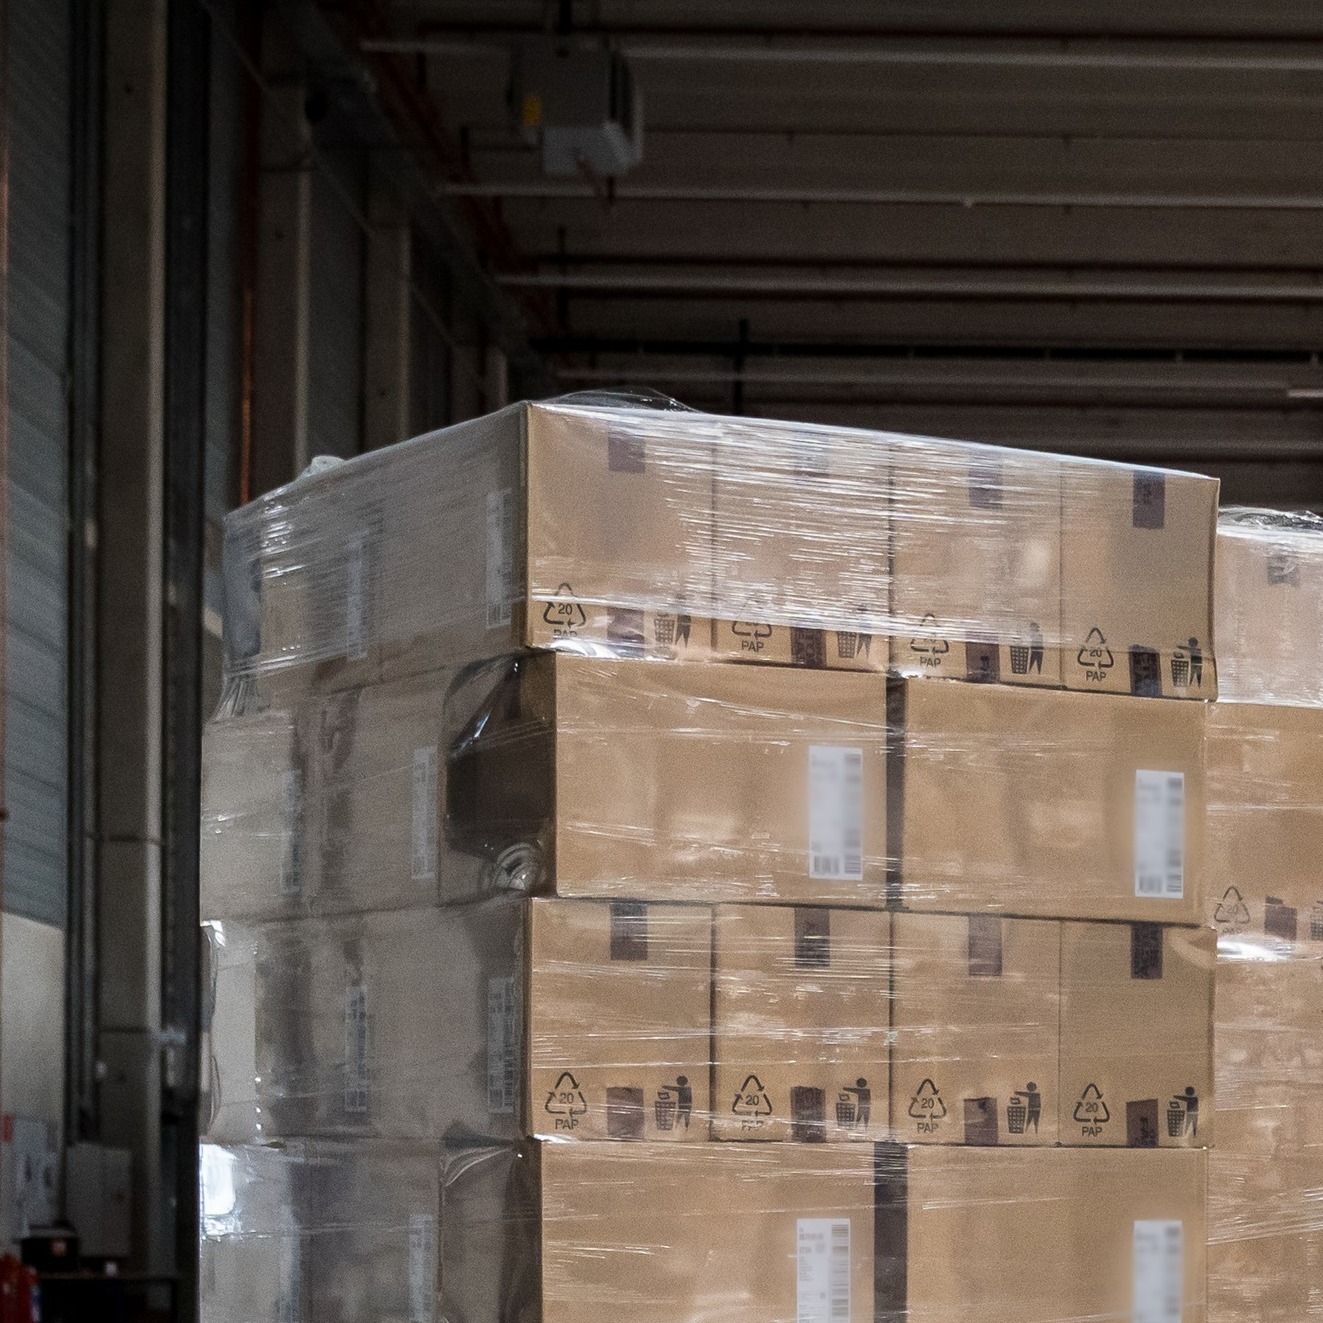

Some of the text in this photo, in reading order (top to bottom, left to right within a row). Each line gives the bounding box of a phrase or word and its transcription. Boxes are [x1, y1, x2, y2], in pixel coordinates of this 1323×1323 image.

[557, 604, 573, 615] 20
[741, 640, 764, 652] PAP
[919, 656, 941, 668] PAP
[1085, 671, 1107, 682] PAP
[559, 1092, 574, 1104] 20
[745, 1094, 760, 1106] 20
[921, 1098, 935, 1109] 20
[1085, 1102, 1099, 1114] 20
[554, 1119, 579, 1130] PAP
[916, 1122, 939, 1134] PAP
[1081, 1126, 1103, 1137] PAP
